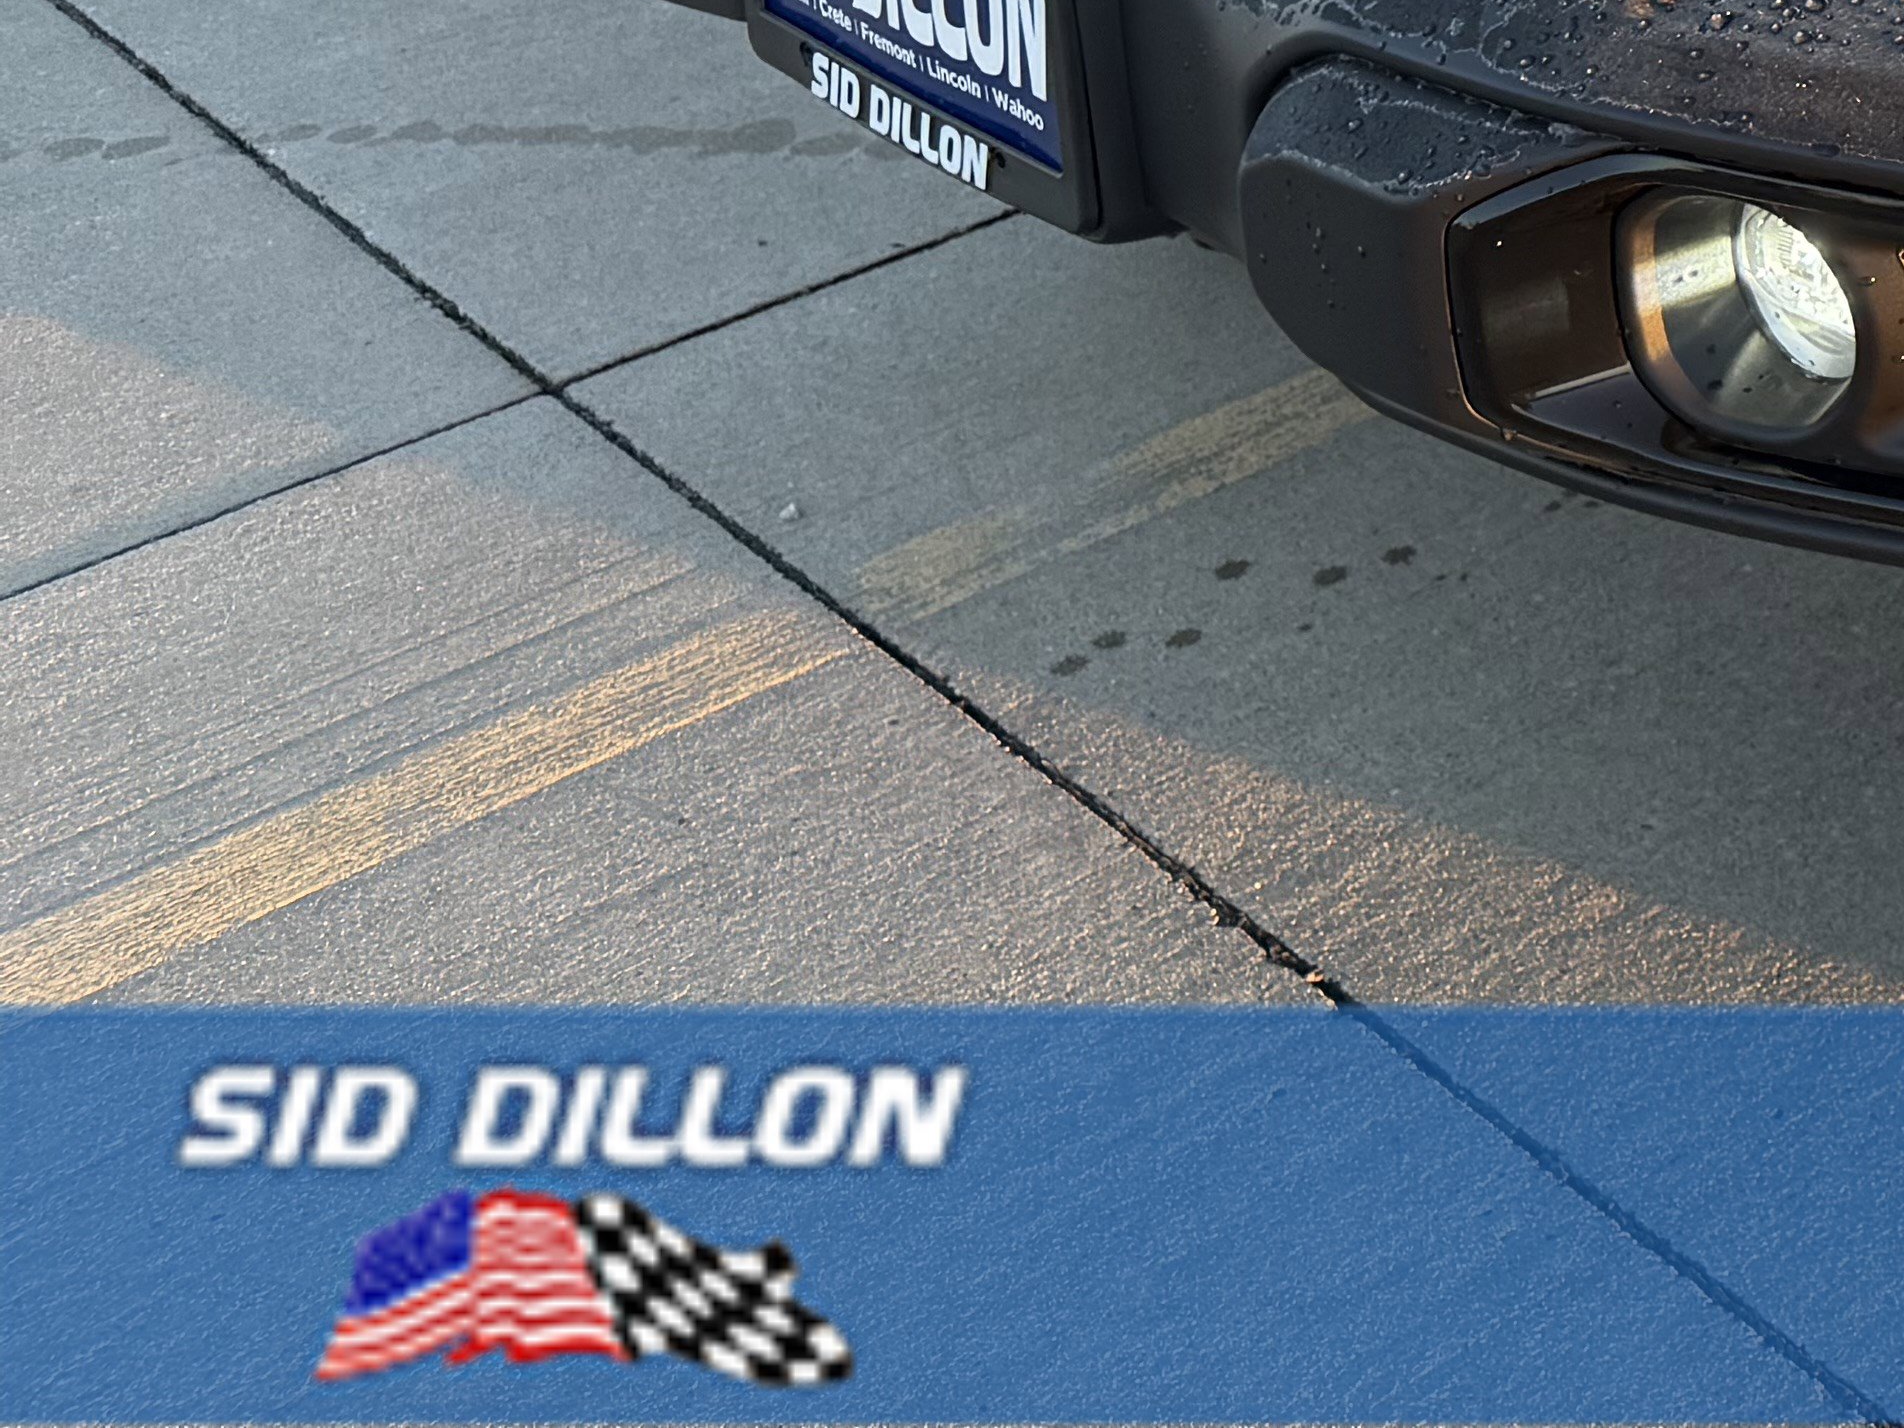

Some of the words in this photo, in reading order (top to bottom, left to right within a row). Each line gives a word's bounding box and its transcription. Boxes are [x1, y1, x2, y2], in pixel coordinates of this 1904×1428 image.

[810, 51, 861, 119] SID
[868, 82, 990, 191] DILLON
[860, 21, 917, 70] Fremont
[926, 58, 982, 100] Lincoln
[992, 86, 1045, 132] Wahoo
